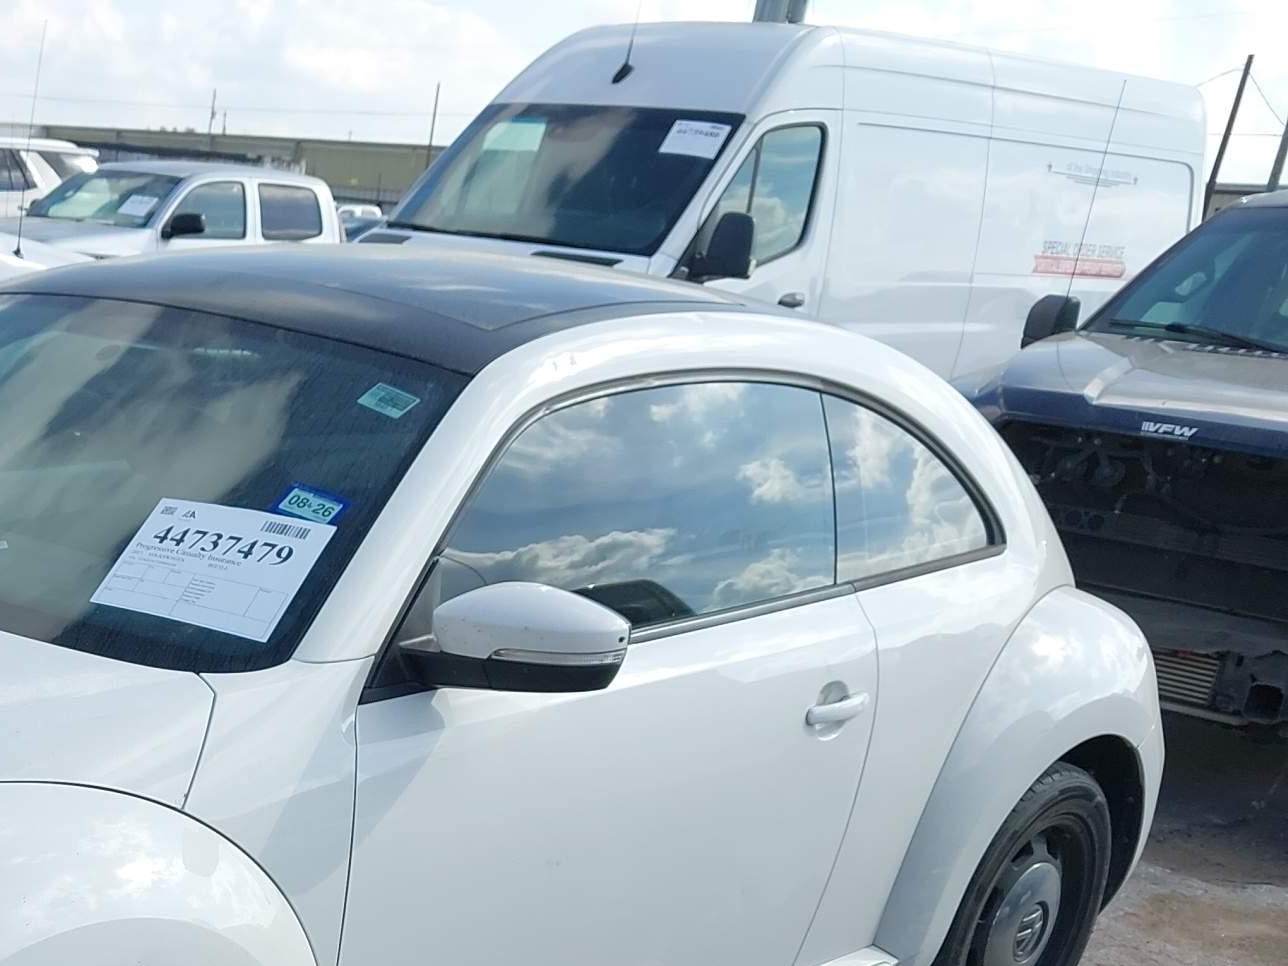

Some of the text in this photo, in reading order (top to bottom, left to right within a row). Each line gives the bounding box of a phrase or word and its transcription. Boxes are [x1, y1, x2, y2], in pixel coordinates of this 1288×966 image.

[288, 494, 336, 518] 08 26
[152, 524, 295, 567] 44737479
